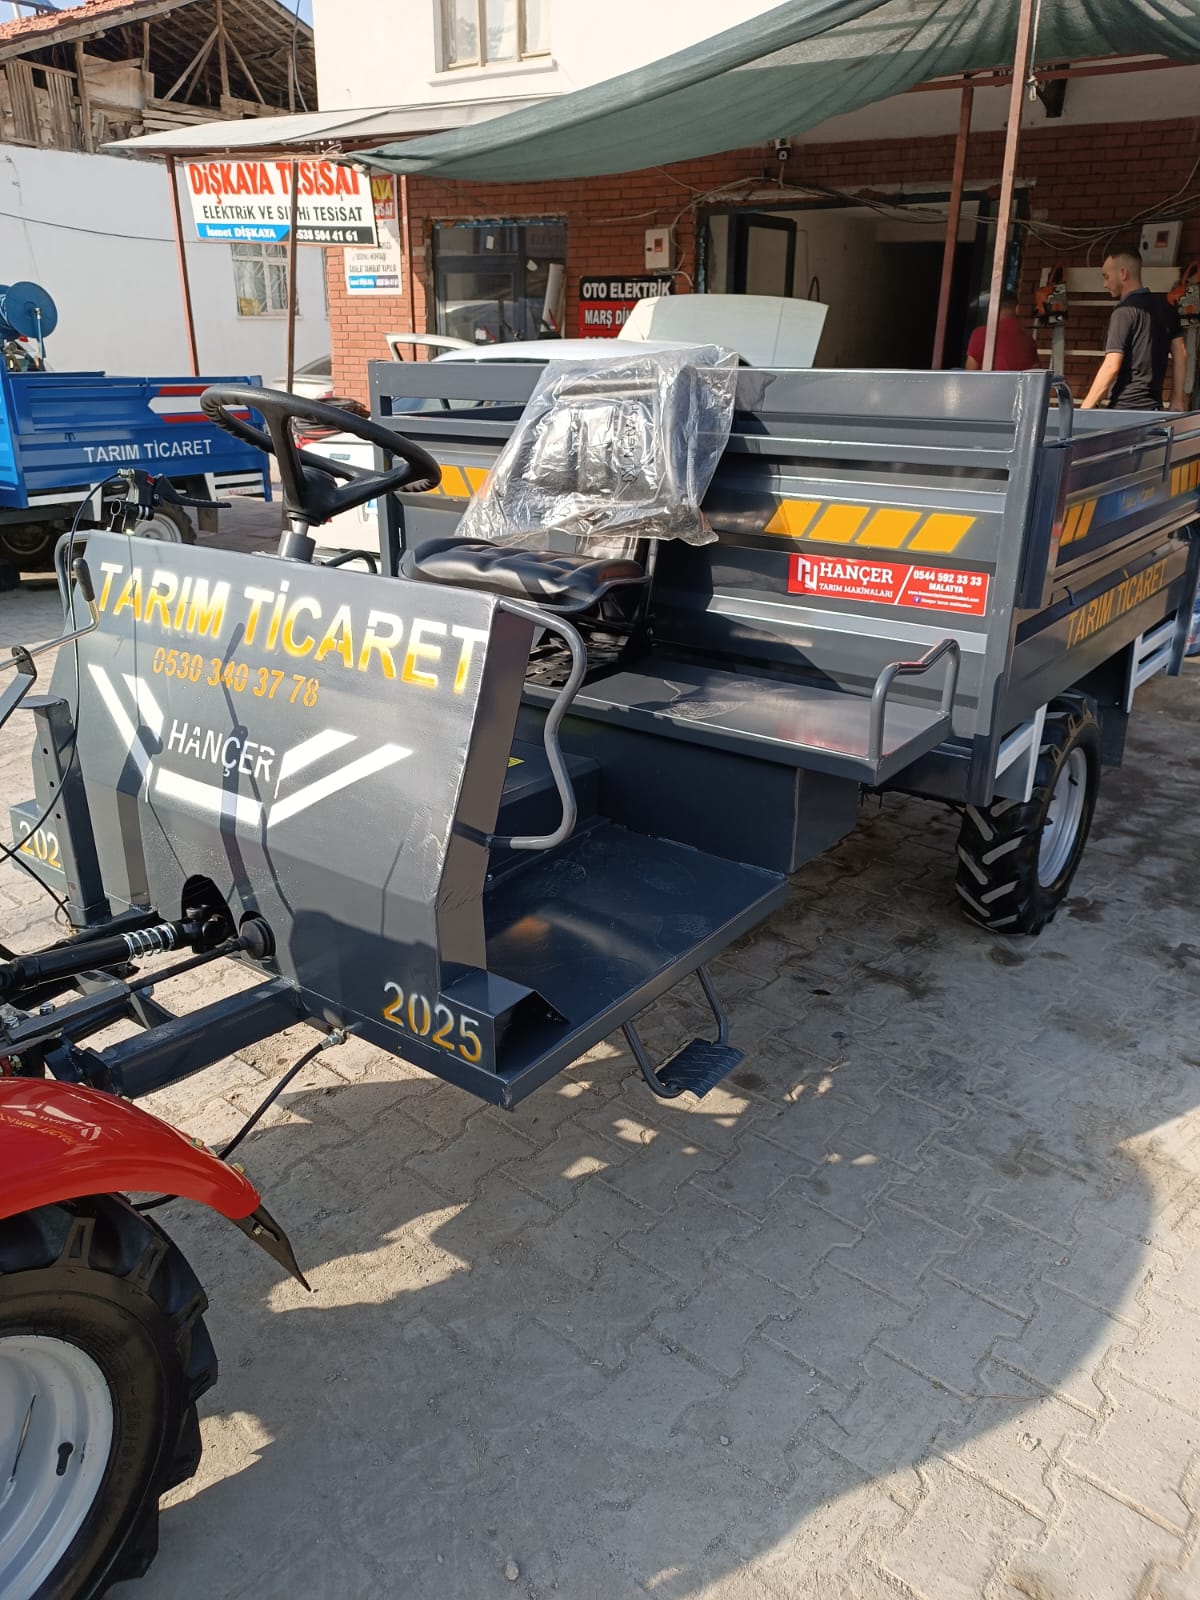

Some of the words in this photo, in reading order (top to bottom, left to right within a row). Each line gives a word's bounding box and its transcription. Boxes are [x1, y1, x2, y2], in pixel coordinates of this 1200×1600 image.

[189, 162, 274, 205] DİŞKAYA
[203, 205, 256, 220] ELEKTRİK
[258, 206, 273, 220] VE
[277, 206, 310, 221] SIHİ
[313, 206, 362, 222] TESİSAT
[296, 229, 313, 240] 538
[314, 229, 330, 241] 504
[332, 230, 343, 242] 41
[346, 230, 358, 242] 61
[583, 282, 607, 298] OTO
[610, 279, 671, 298] ELEKTRİK
[585, 309, 613, 329] MARŞ
[83, 444, 140, 463] TARIM
[143, 440, 211, 459] TİCARET
[819, 562, 893, 586] HANÇER
[913, 569, 935, 581] 0544
[818, 582, 842, 592] TARIM
[928, 582, 963, 594] MALATYA
[1066, 588, 1115, 651] TARIM
[1116, 559, 1168, 617] TİCARET
[98, 561, 231, 640] TARIM
[243, 579, 489, 695] TİCARET
[153, 647, 203, 682] 0530
[206, 657, 249, 693] 340
[252, 667, 285, 699] 37
[289, 674, 320, 708] 78
[168, 719, 275, 782] HANÇER
[19, 821, 62, 868] 202
[382, 981, 482, 1063] 2025
